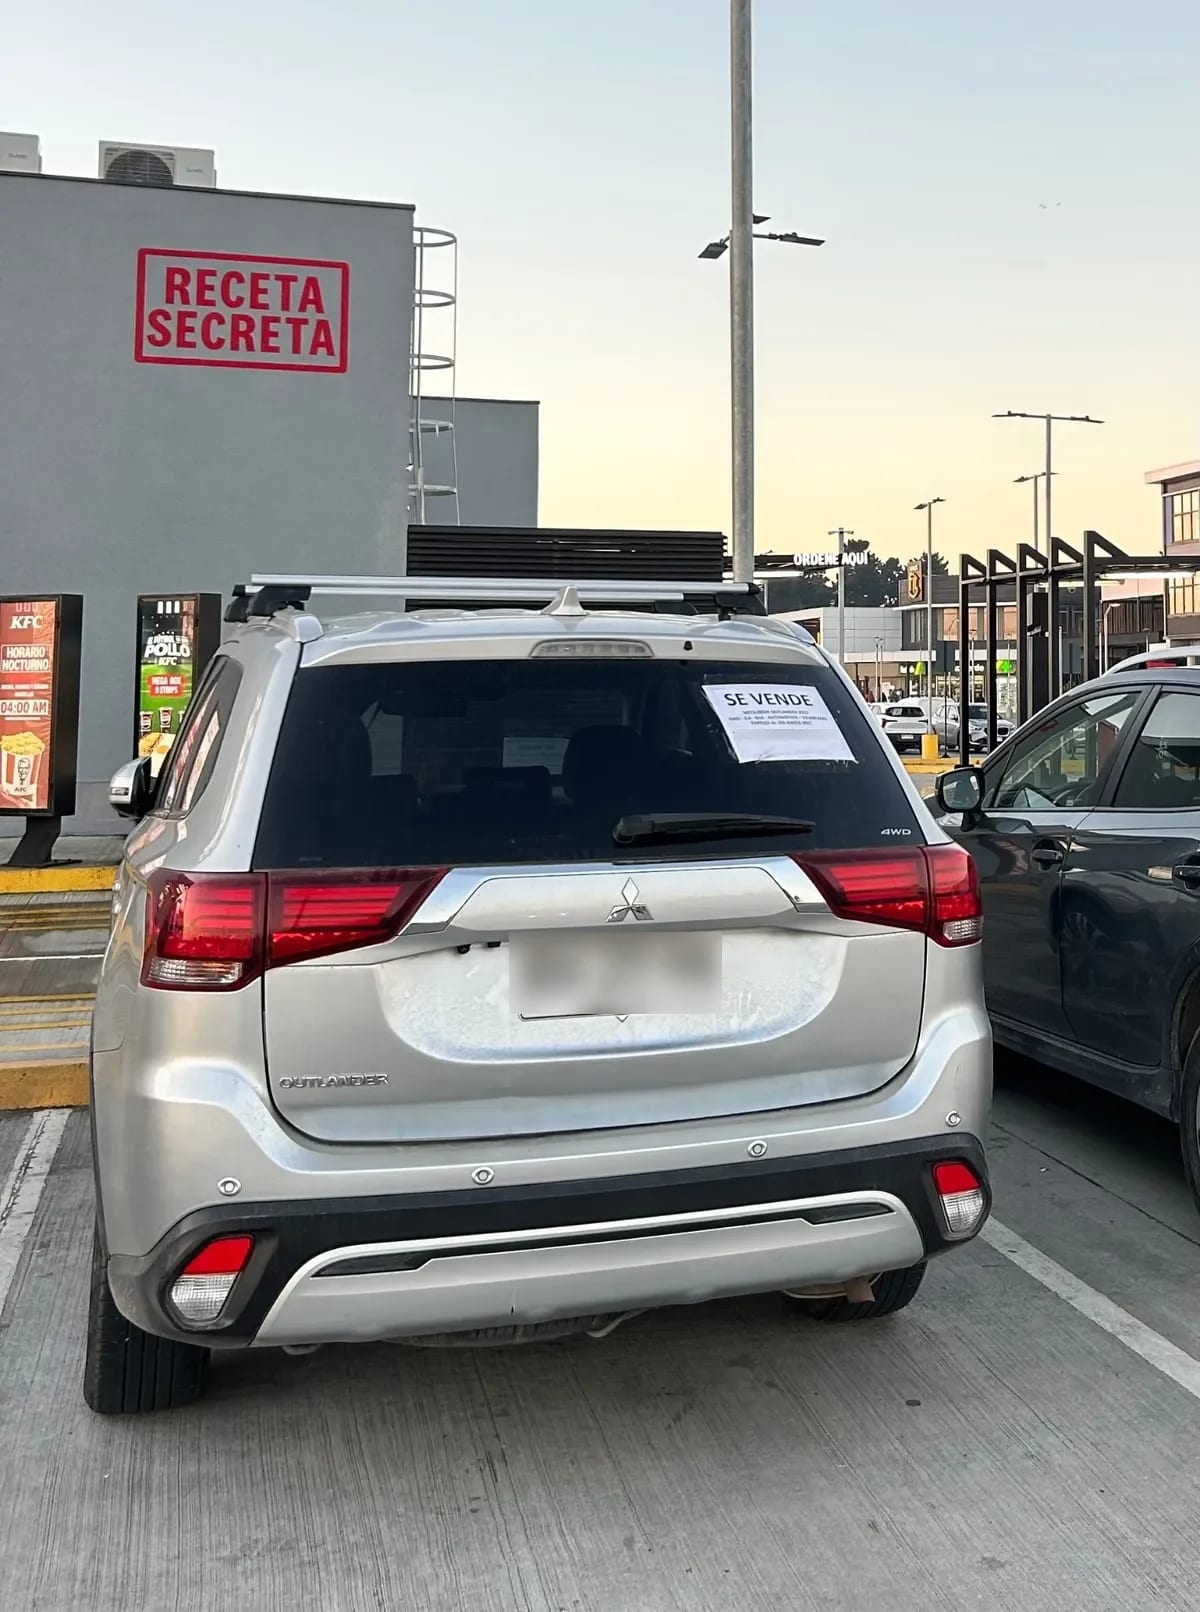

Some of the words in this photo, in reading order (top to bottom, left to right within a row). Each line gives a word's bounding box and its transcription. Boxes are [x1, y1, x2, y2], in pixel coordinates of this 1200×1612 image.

[165, 265, 326, 314] RECETA
[146, 307, 337, 357] SECRETA
[793, 553, 840, 566] ORDENE
[841, 550, 868, 567] AQUÍ
[10, 615, 43, 630] KFC
[6, 646, 46, 659] HORARIO
[143, 642, 191, 658] POLLO
[2, 658, 49, 671] NOCTURNO
[158, 657, 178, 666] KFC
[724, 693, 749, 706] SE
[749, 693, 814, 707] VENDE
[1, 701, 30, 714] 04:00
[32, 701, 47, 713] AM
[880, 827, 912, 837] 4WD
[279, 1073, 389, 1089] OUTLANDER
